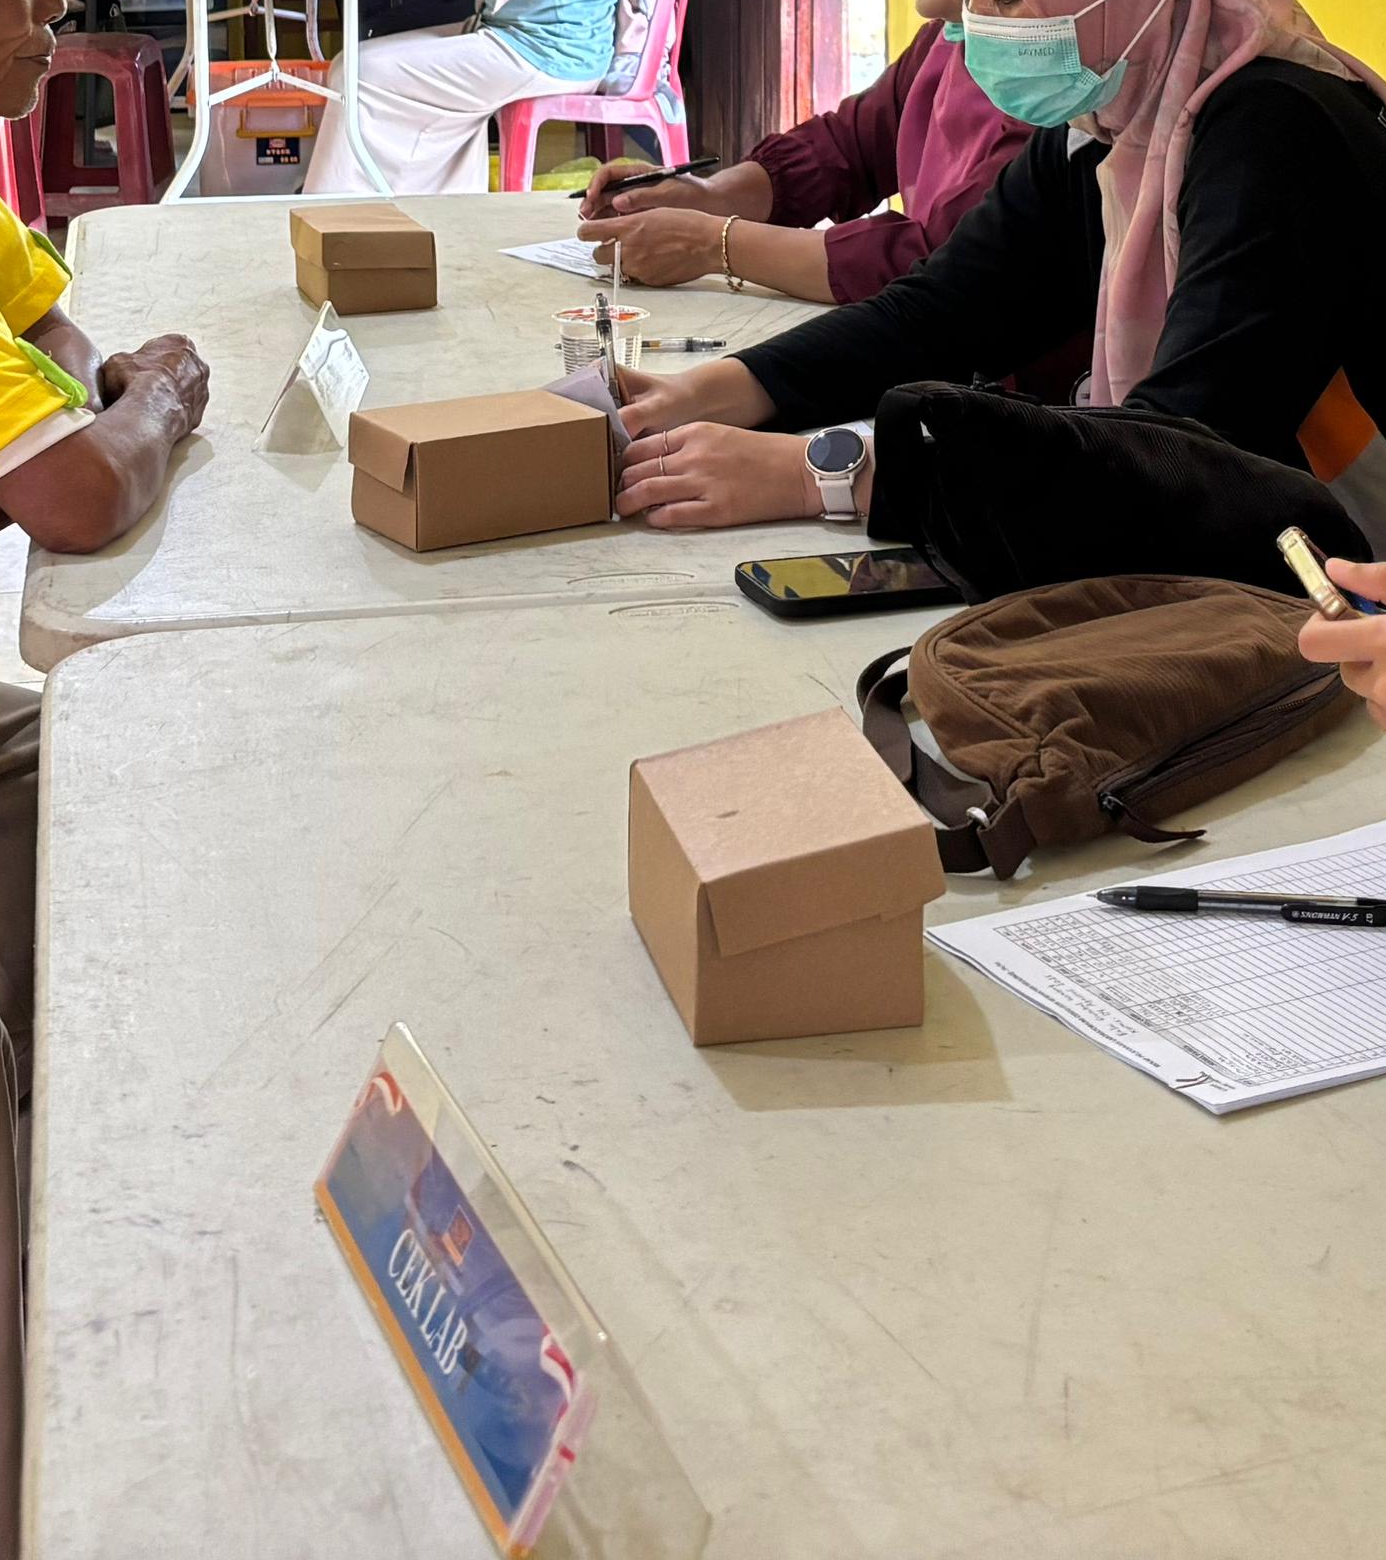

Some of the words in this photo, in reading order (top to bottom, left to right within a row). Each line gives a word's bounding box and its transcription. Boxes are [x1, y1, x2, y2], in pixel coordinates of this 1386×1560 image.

[1300, 911, 1340, 921] SNOWMAN
[388, 1228, 437, 1319] CEK
[420, 1282, 468, 1375] LAB
